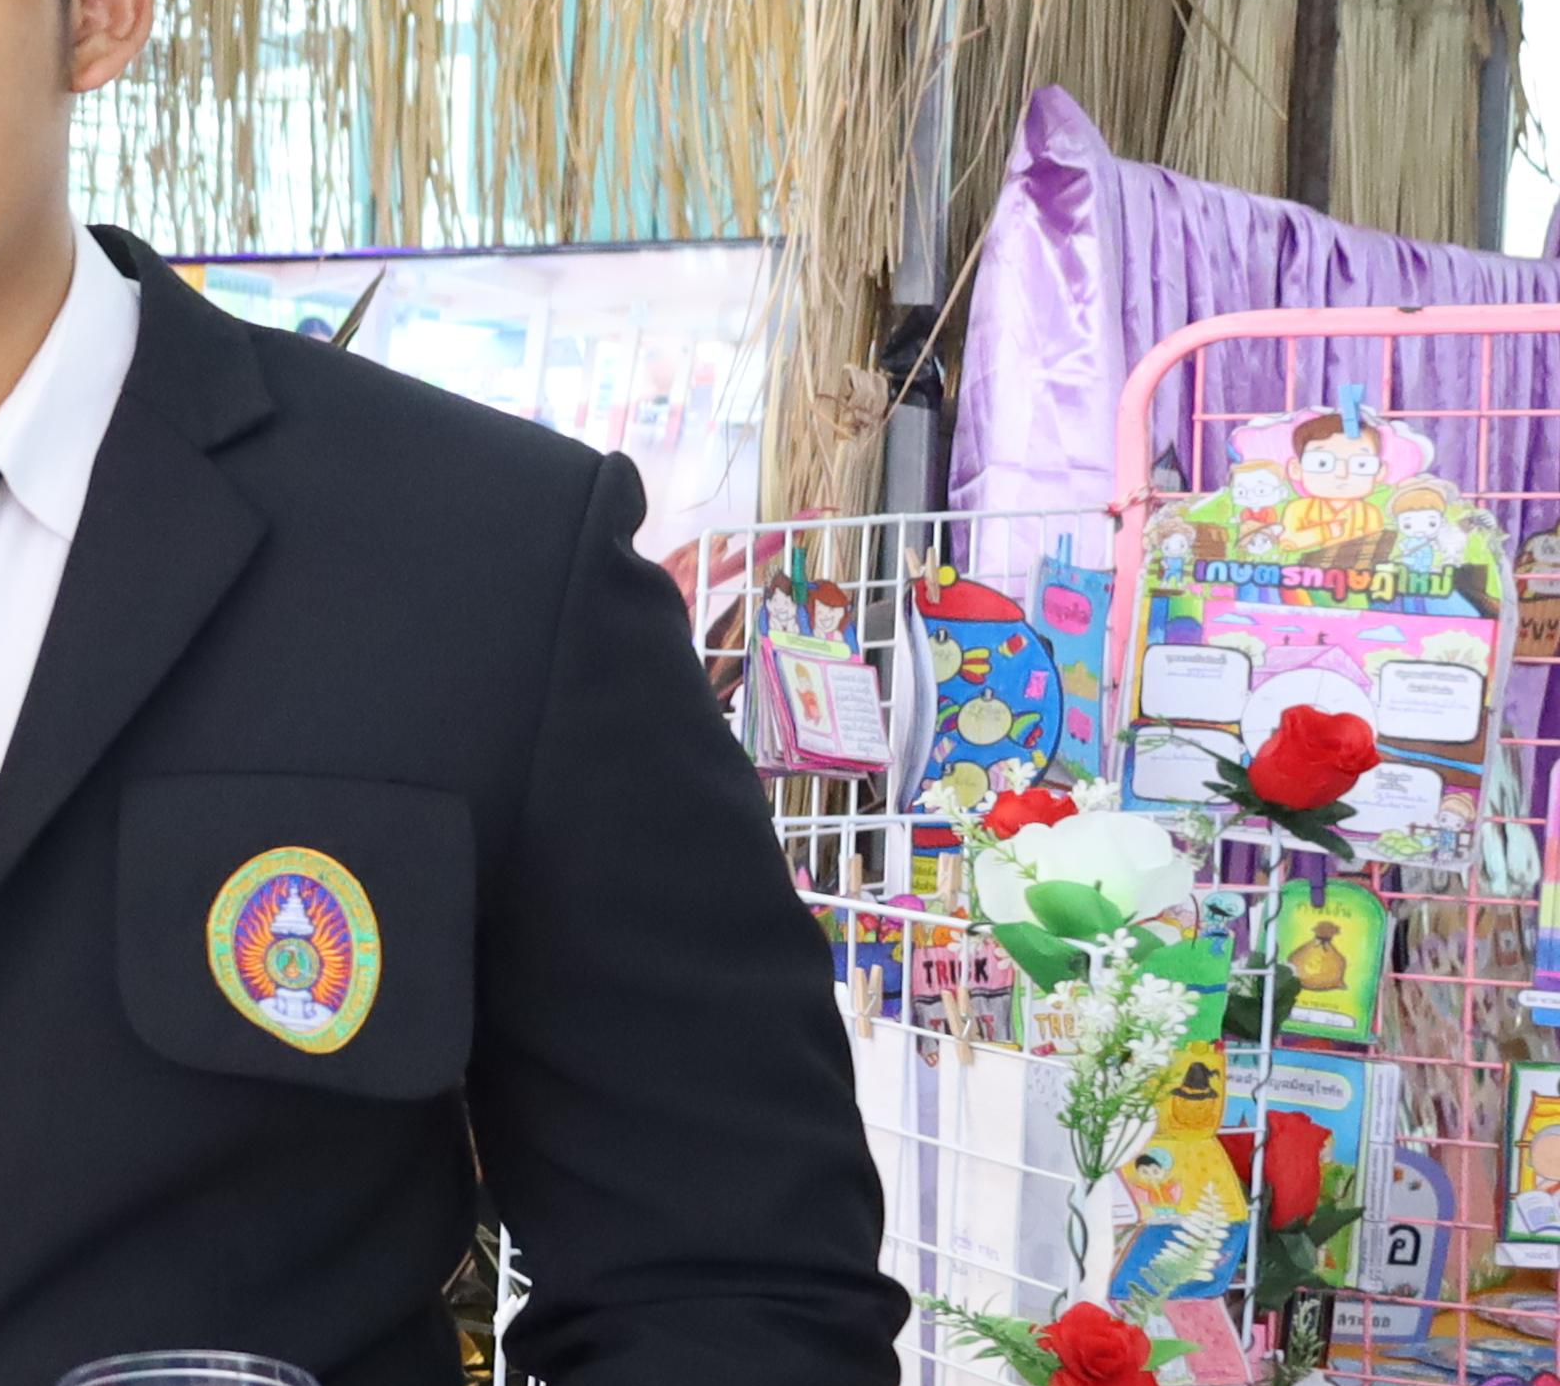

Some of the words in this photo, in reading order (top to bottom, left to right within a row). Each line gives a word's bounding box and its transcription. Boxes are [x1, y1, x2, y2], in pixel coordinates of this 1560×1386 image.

[1193, 559, 1457, 602] เกษตรทฤษฎีใหม่
[922, 957, 990, 987] TRIK
